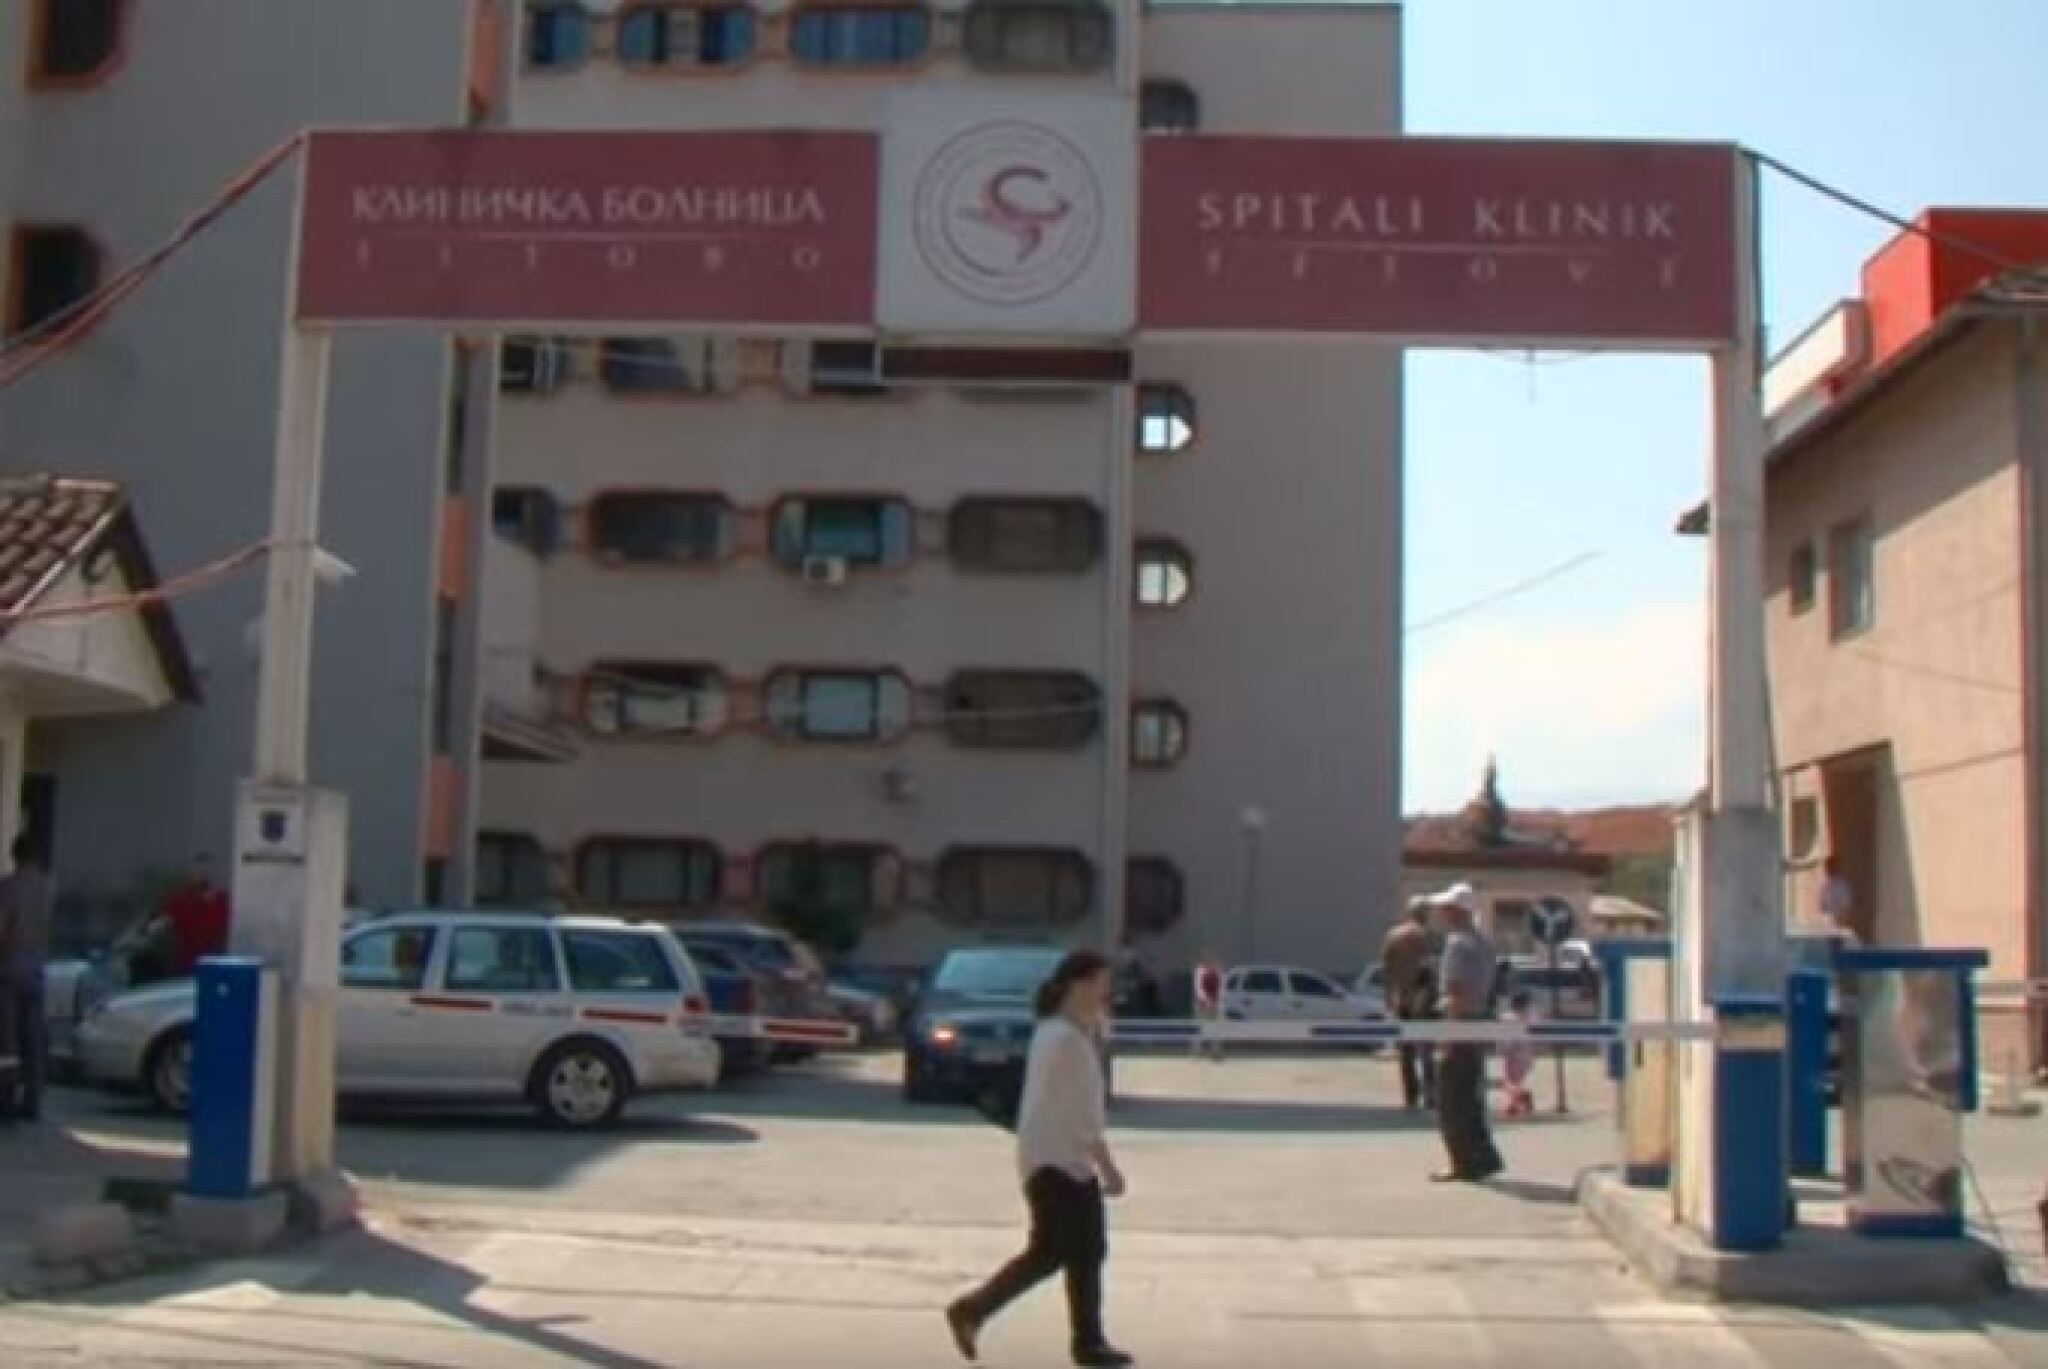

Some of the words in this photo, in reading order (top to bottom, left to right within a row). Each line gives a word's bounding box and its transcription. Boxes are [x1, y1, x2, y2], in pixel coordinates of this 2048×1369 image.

[352, 185, 592, 223] КЛИНИЧКА
[604, 186, 827, 224] БОЛНИЦА
[1199, 192, 1424, 235] SPITALI
[1473, 198, 1676, 240] KLINIK
